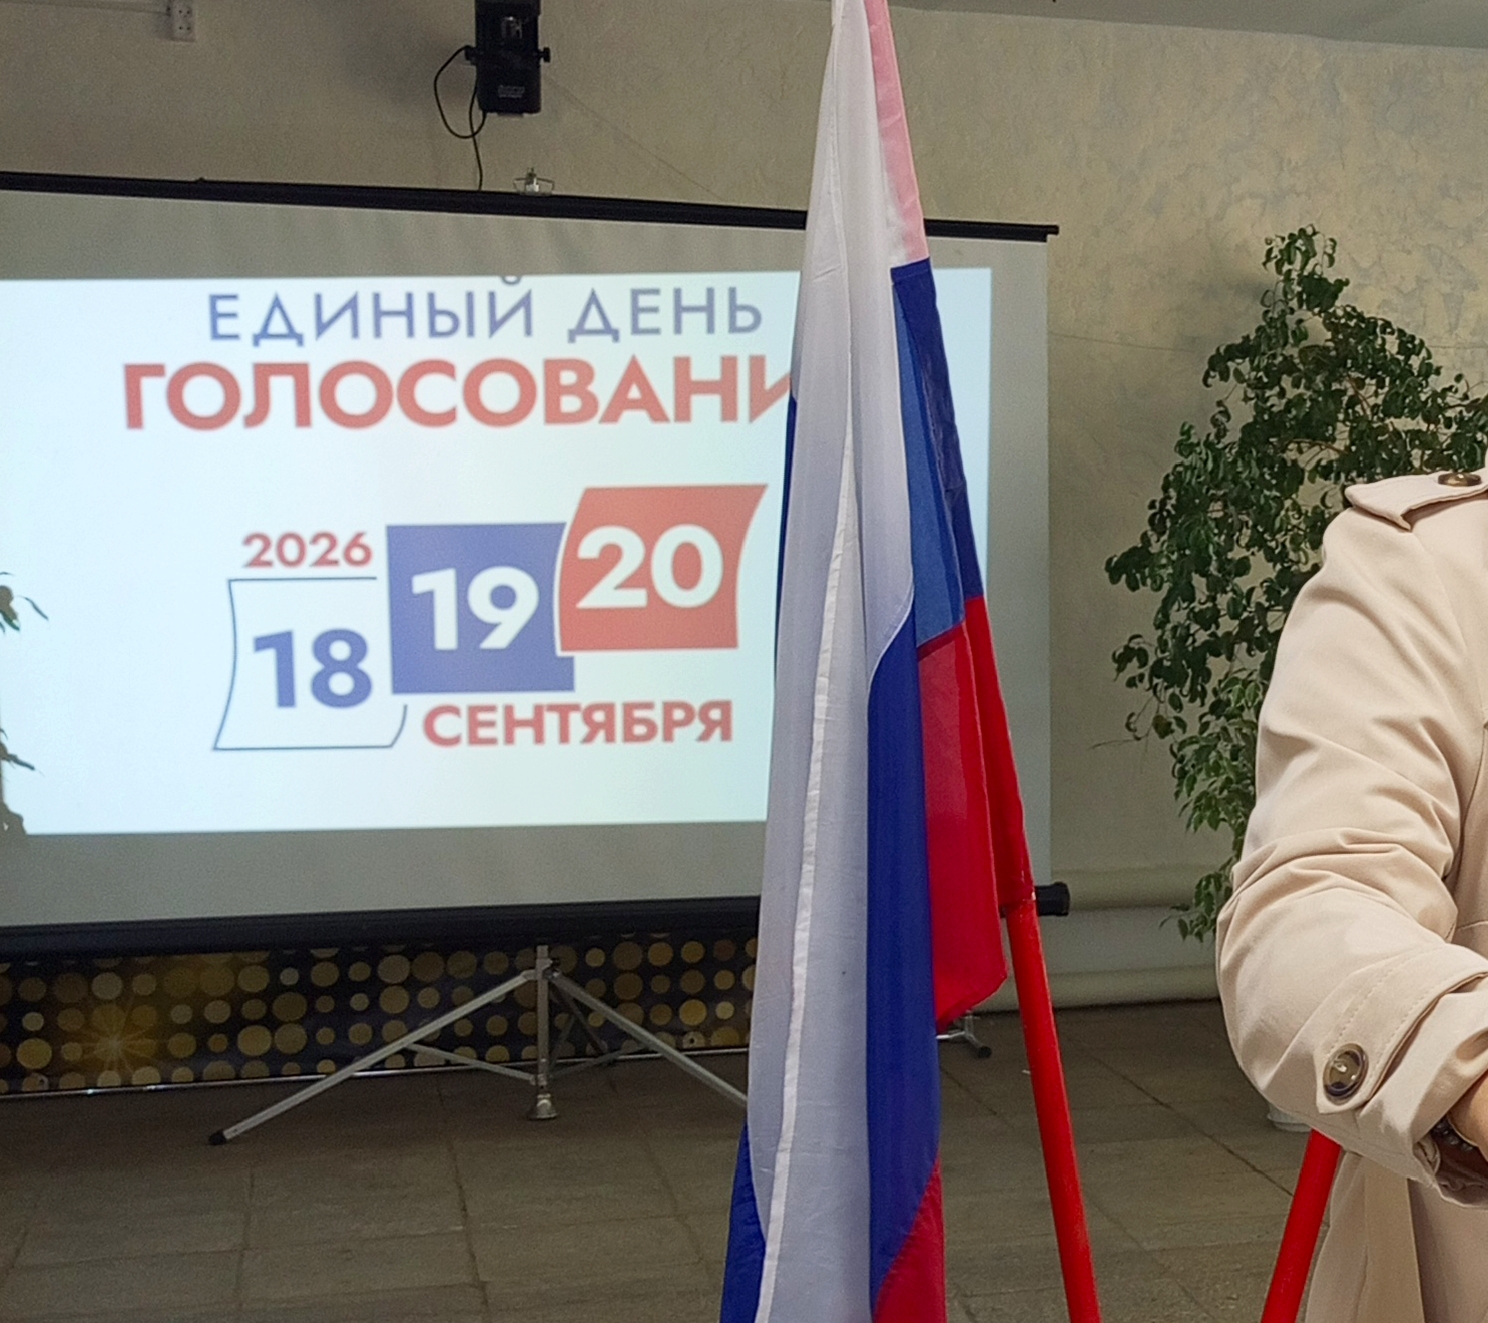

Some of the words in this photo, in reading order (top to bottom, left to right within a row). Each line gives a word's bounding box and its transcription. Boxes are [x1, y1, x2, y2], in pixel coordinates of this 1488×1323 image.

[208, 276, 533, 348] ЕДИНЫЙ
[567, 286, 763, 344] ДЕНЬ
[123, 354, 791, 431] ГОЛОСОВАНИ
[241, 532, 373, 568] 2026
[575, 523, 724, 609] 20
[411, 565, 540, 650] 19
[253, 628, 372, 709] 18
[422, 699, 734, 747] СЕНТЯБРЯ
